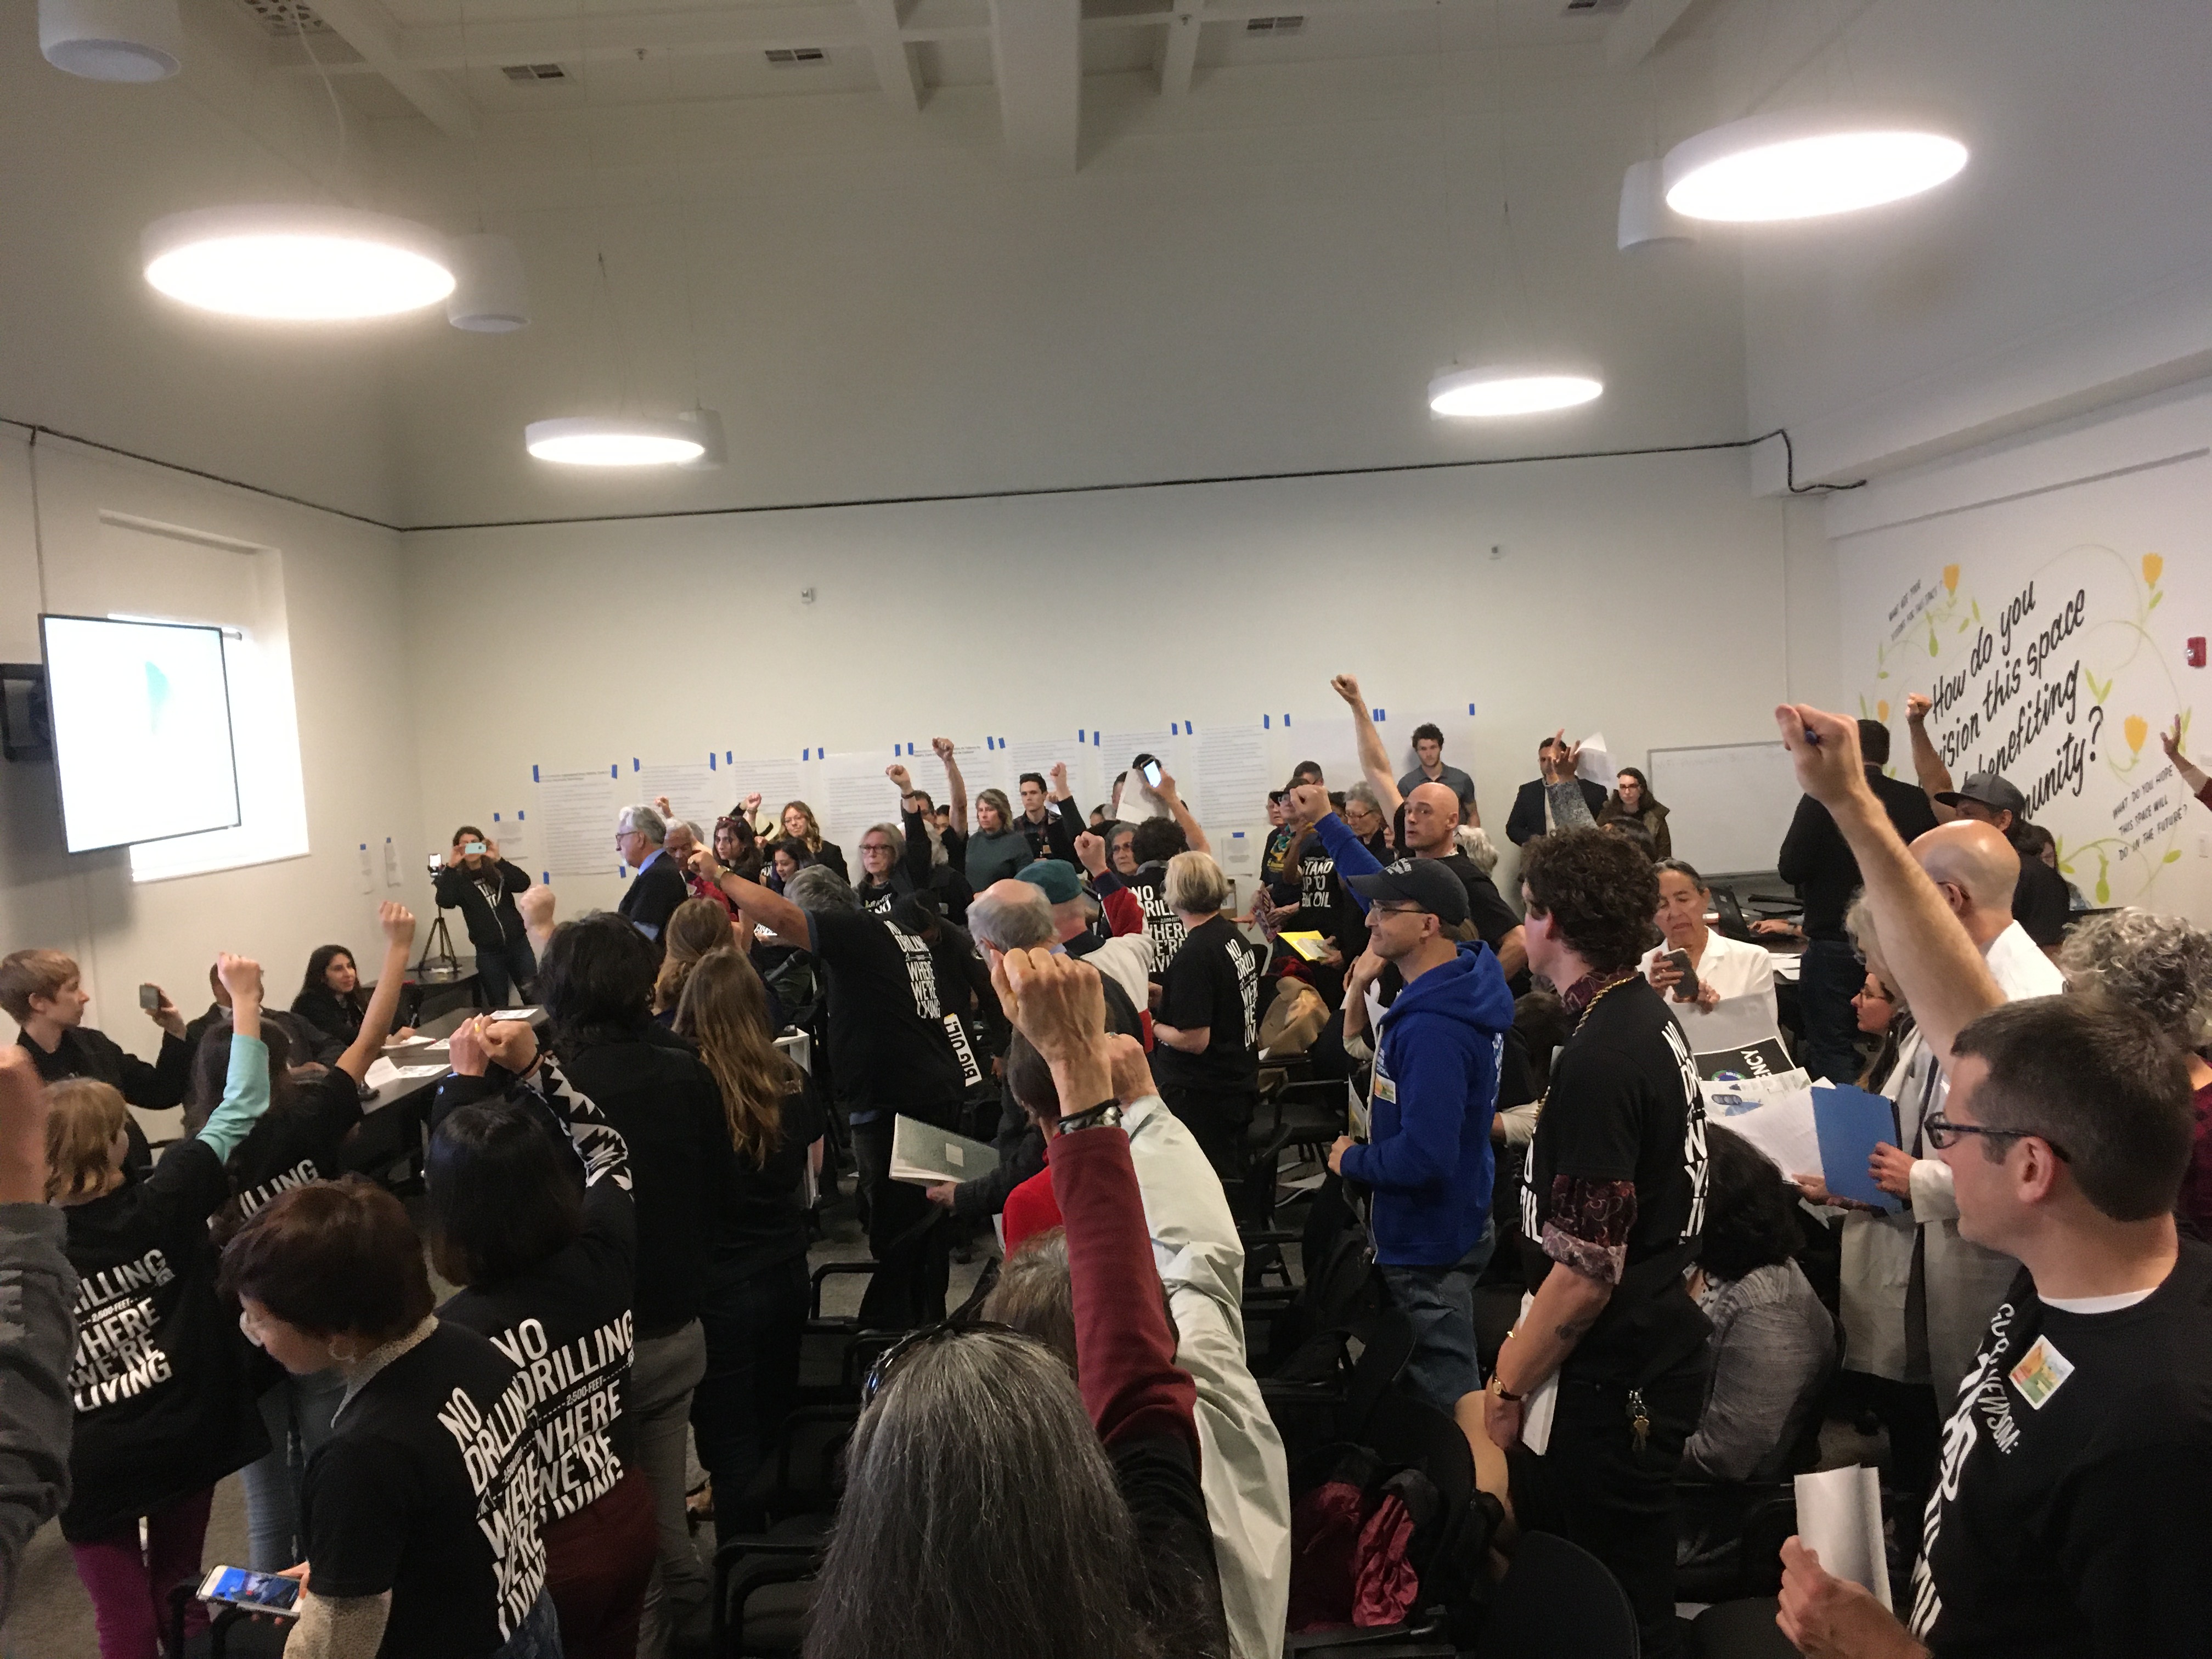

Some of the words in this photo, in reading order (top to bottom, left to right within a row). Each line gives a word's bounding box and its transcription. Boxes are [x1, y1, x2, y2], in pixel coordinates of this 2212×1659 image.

[1933, 669, 1966, 724] How
[1970, 626, 1993, 678] do
[2000, 580, 2036, 656] you
[1982, 658, 2021, 723] this
[2027, 589, 2085, 680] space
[2021, 705, 2103, 820] unity?
[2113, 796, 2128, 820] WHAT
[2131, 788, 2140, 802] DO
[2141, 779, 2154, 795] YOU
[2118, 820, 2134, 836] THIS
[2135, 804, 2152, 825] SPACE
[2153, 794, 2168, 812] WILL
[2118, 846, 2129, 861] DO
[2132, 838, 2140, 852] IN
[2142, 827, 2154, 844] THE
[1132, 885, 1154, 901] NO
[1313, 891, 1331, 908] OIL
[1148, 922, 1188, 940] HER
[1224, 938, 1242, 962] NO
[906, 961, 935, 982] WHERE
[911, 980, 938, 1002] WE'RE
[959, 1052, 978, 1081] BIG
[73, 1249, 167, 1314] ILLING
[74, 1352, 173, 1412] LIVING
[437, 1387, 482, 1454] NO
[535, 1379, 623, 1464] WHERE
[478, 1450, 539, 1559] WHERE
